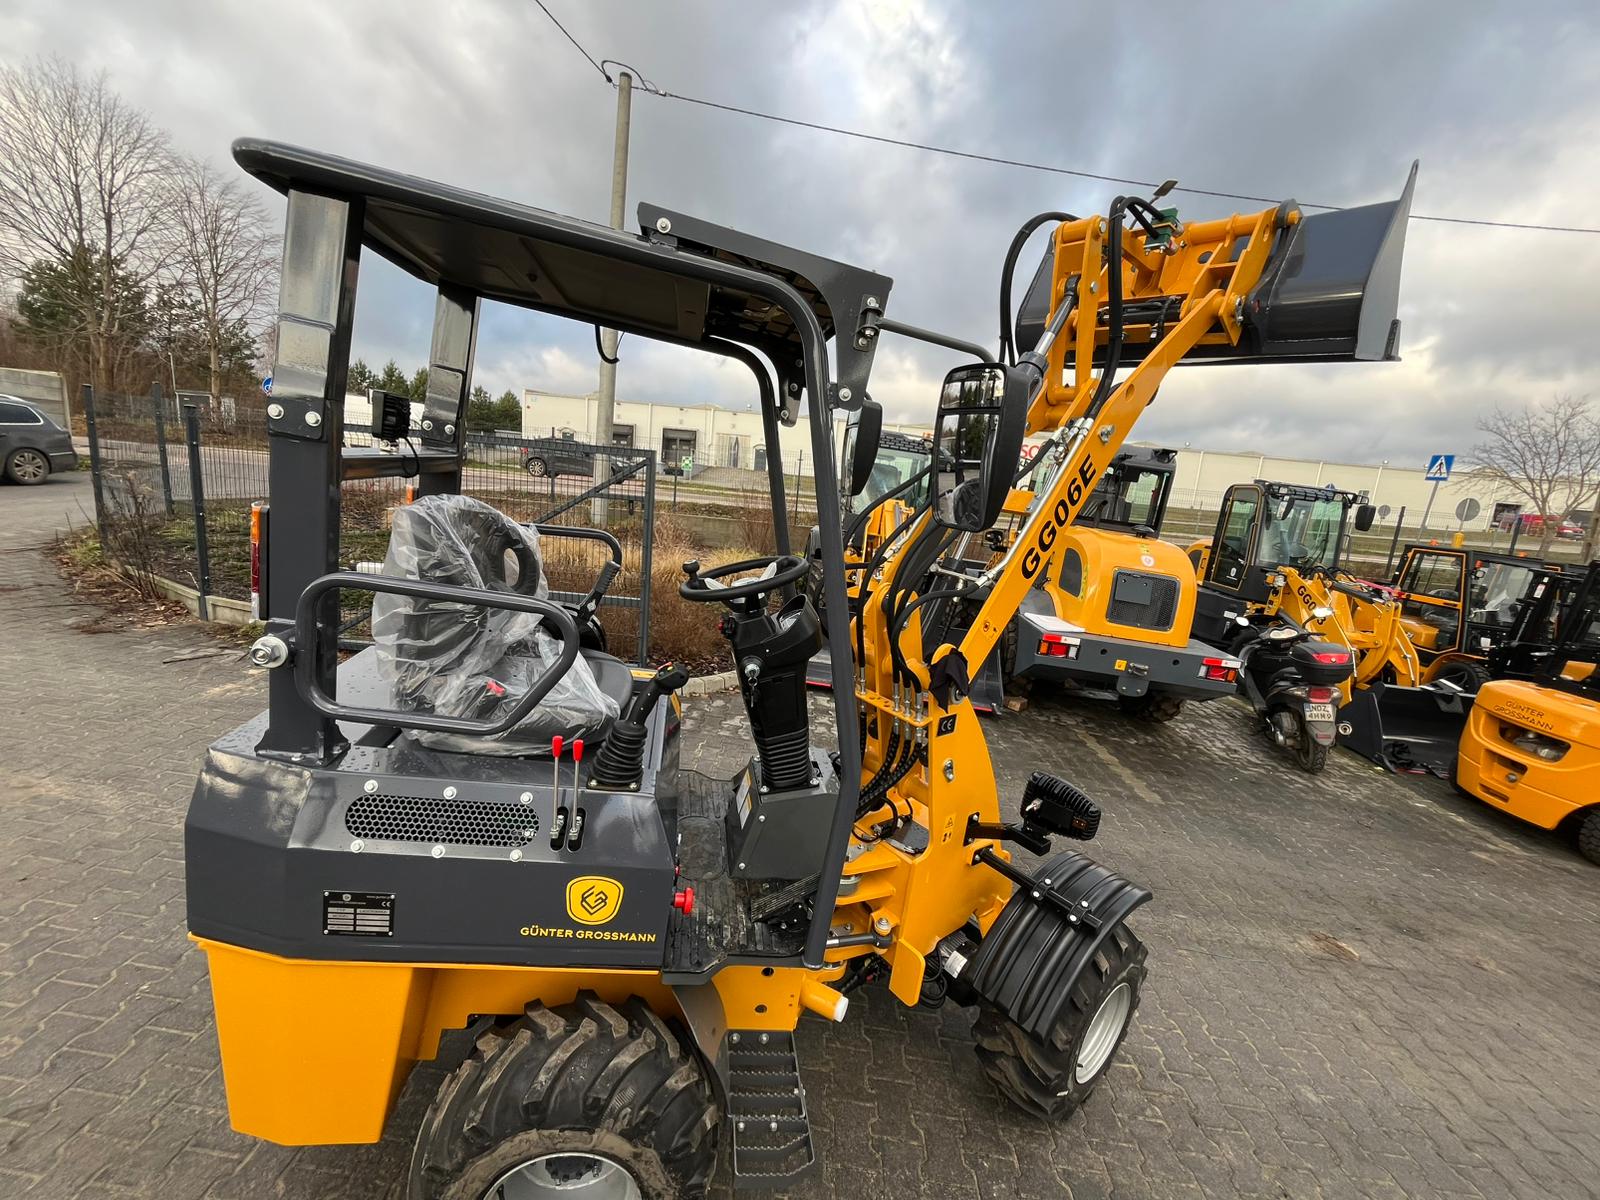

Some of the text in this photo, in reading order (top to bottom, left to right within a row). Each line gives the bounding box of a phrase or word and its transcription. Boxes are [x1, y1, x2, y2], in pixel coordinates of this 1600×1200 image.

[1021, 453, 1097, 580] GG06E
[941, 719, 953, 732] CE
[1493, 704, 1554, 731] GROSSMANN
[520, 925, 657, 943] GÜNTER GROSSMANN
